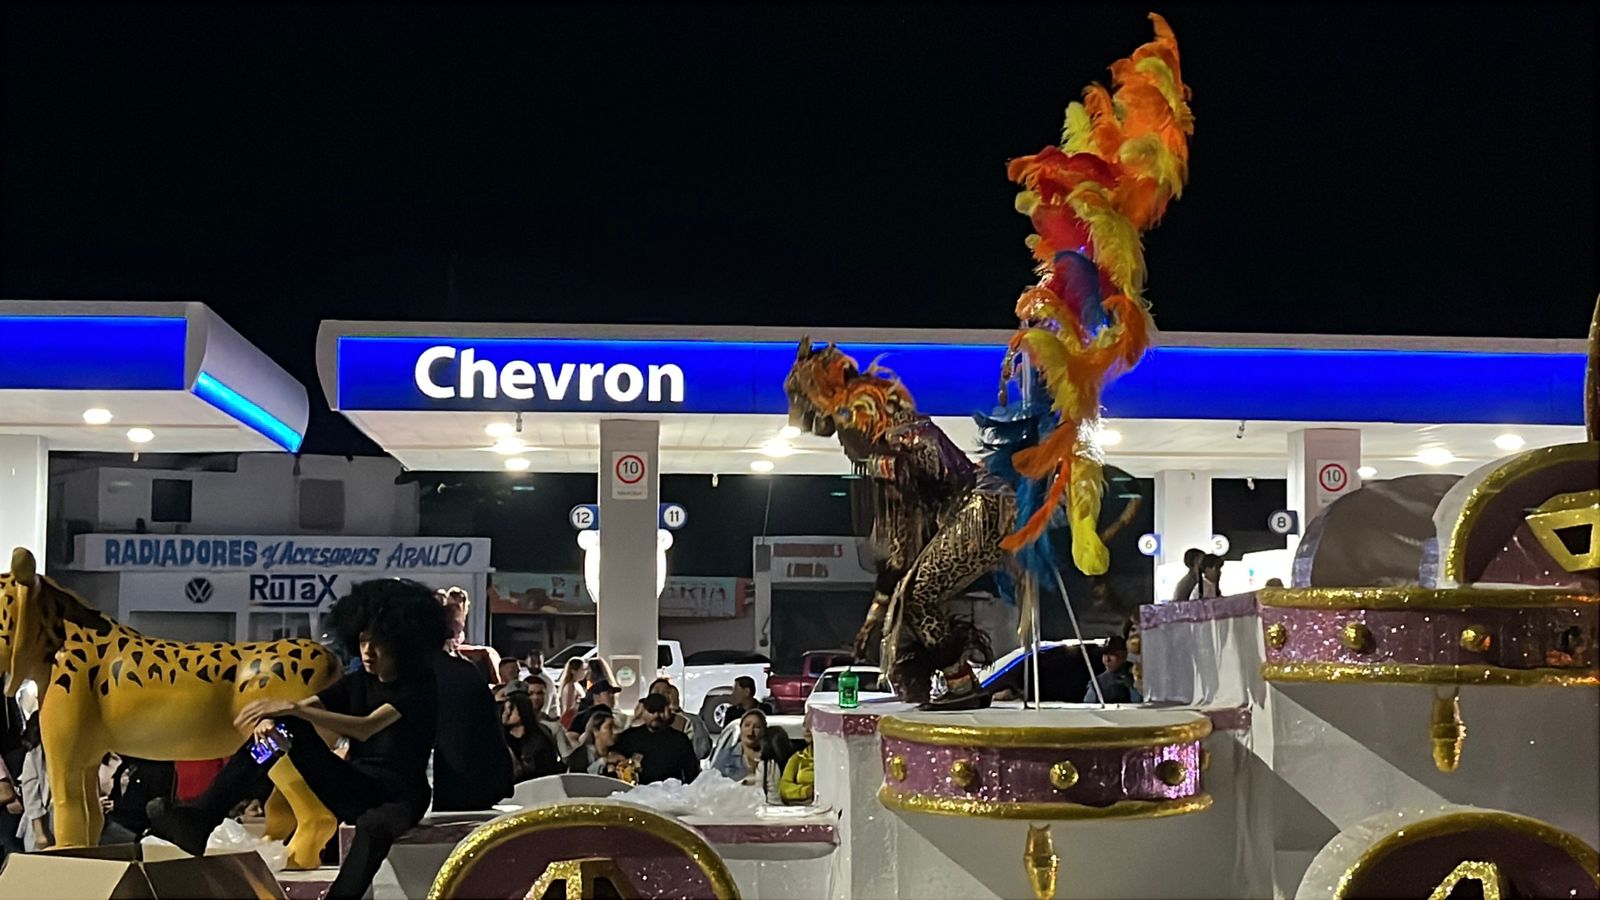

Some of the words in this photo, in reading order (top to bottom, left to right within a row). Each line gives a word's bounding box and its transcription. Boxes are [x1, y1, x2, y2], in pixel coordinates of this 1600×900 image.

[414, 345, 684, 402] Chevron
[622, 461, 639, 474] 10
[1326, 470, 1341, 482] 10
[575, 511, 590, 523] 12
[669, 510, 680, 522] 11
[1277, 516, 1286, 528] 8
[1145, 540, 1153, 550] 6
[1215, 540, 1222, 550] 5
[105, 538, 258, 567] RADIADORES
[386, 541, 472, 569] ARAUJO
